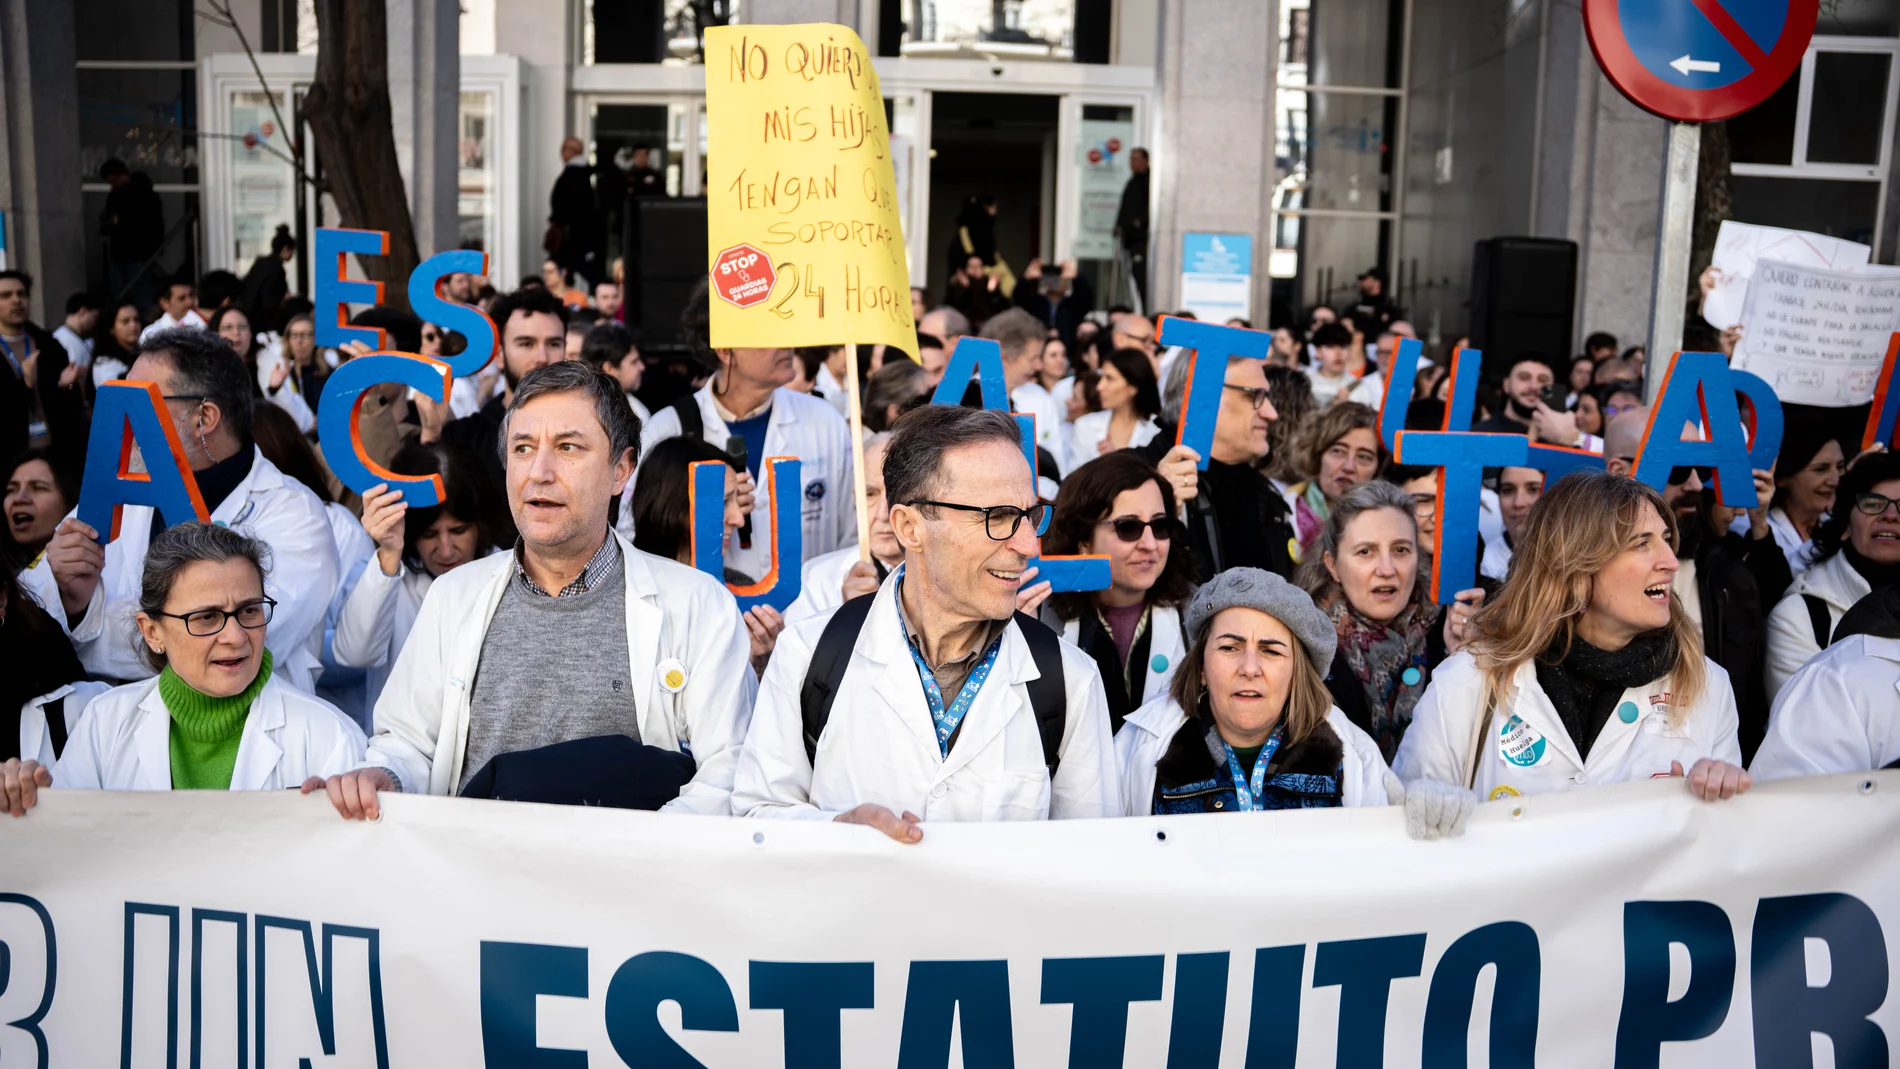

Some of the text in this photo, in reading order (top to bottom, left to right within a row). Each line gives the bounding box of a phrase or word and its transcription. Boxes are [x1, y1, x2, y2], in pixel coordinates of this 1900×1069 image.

[730, 36, 768, 83] NO
[785, 36, 862, 90] QUIERO
[764, 105, 817, 144] MIS
[729, 164, 838, 215] TENGAN
[762, 220, 898, 265] SOPORTAR
[720, 253, 758, 275] STOP
[729, 277, 767, 295] GUARDIAS
[732, 284, 769, 302] 24 HORAS
[769, 261, 911, 328] 24 HORAS
[1501, 728, 1524, 746] Médico
[1509, 736, 1533, 754] Huelga
